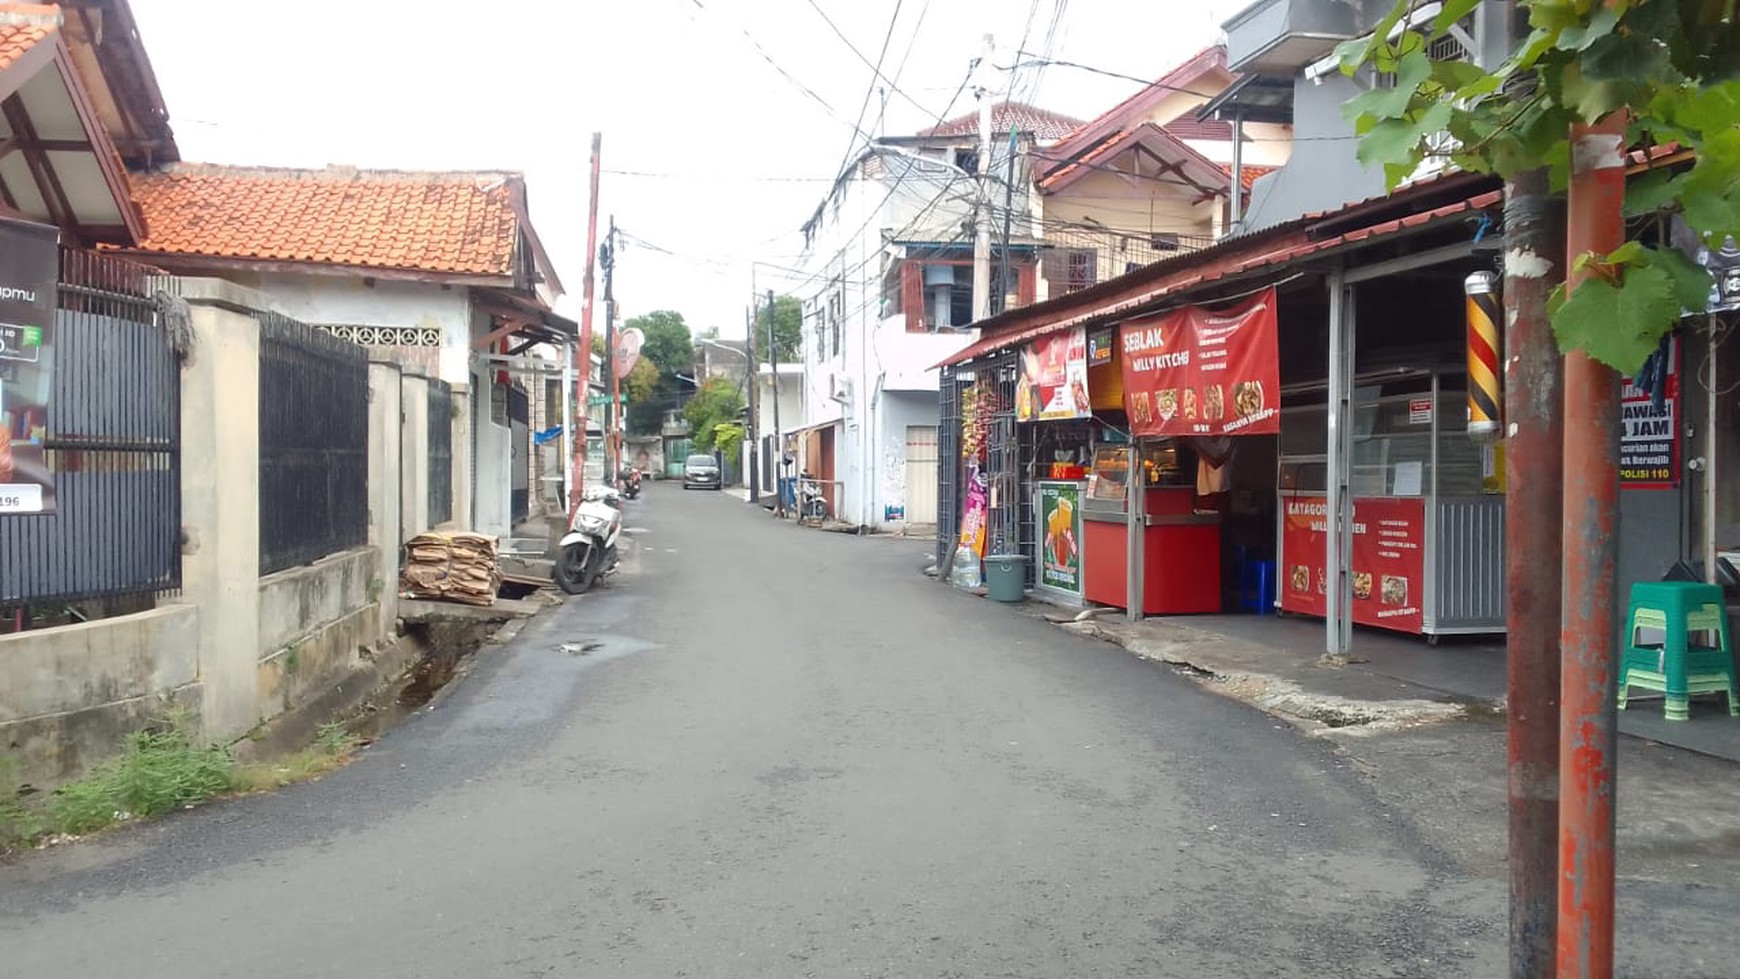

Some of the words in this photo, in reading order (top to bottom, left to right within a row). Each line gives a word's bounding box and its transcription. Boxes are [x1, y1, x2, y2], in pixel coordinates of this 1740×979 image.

[0, 286, 35, 302] pmu
[1124, 328, 1165, 352] SEBLAK
[1632, 420, 1669, 436] JAM
[1651, 468, 1670, 478] 110
